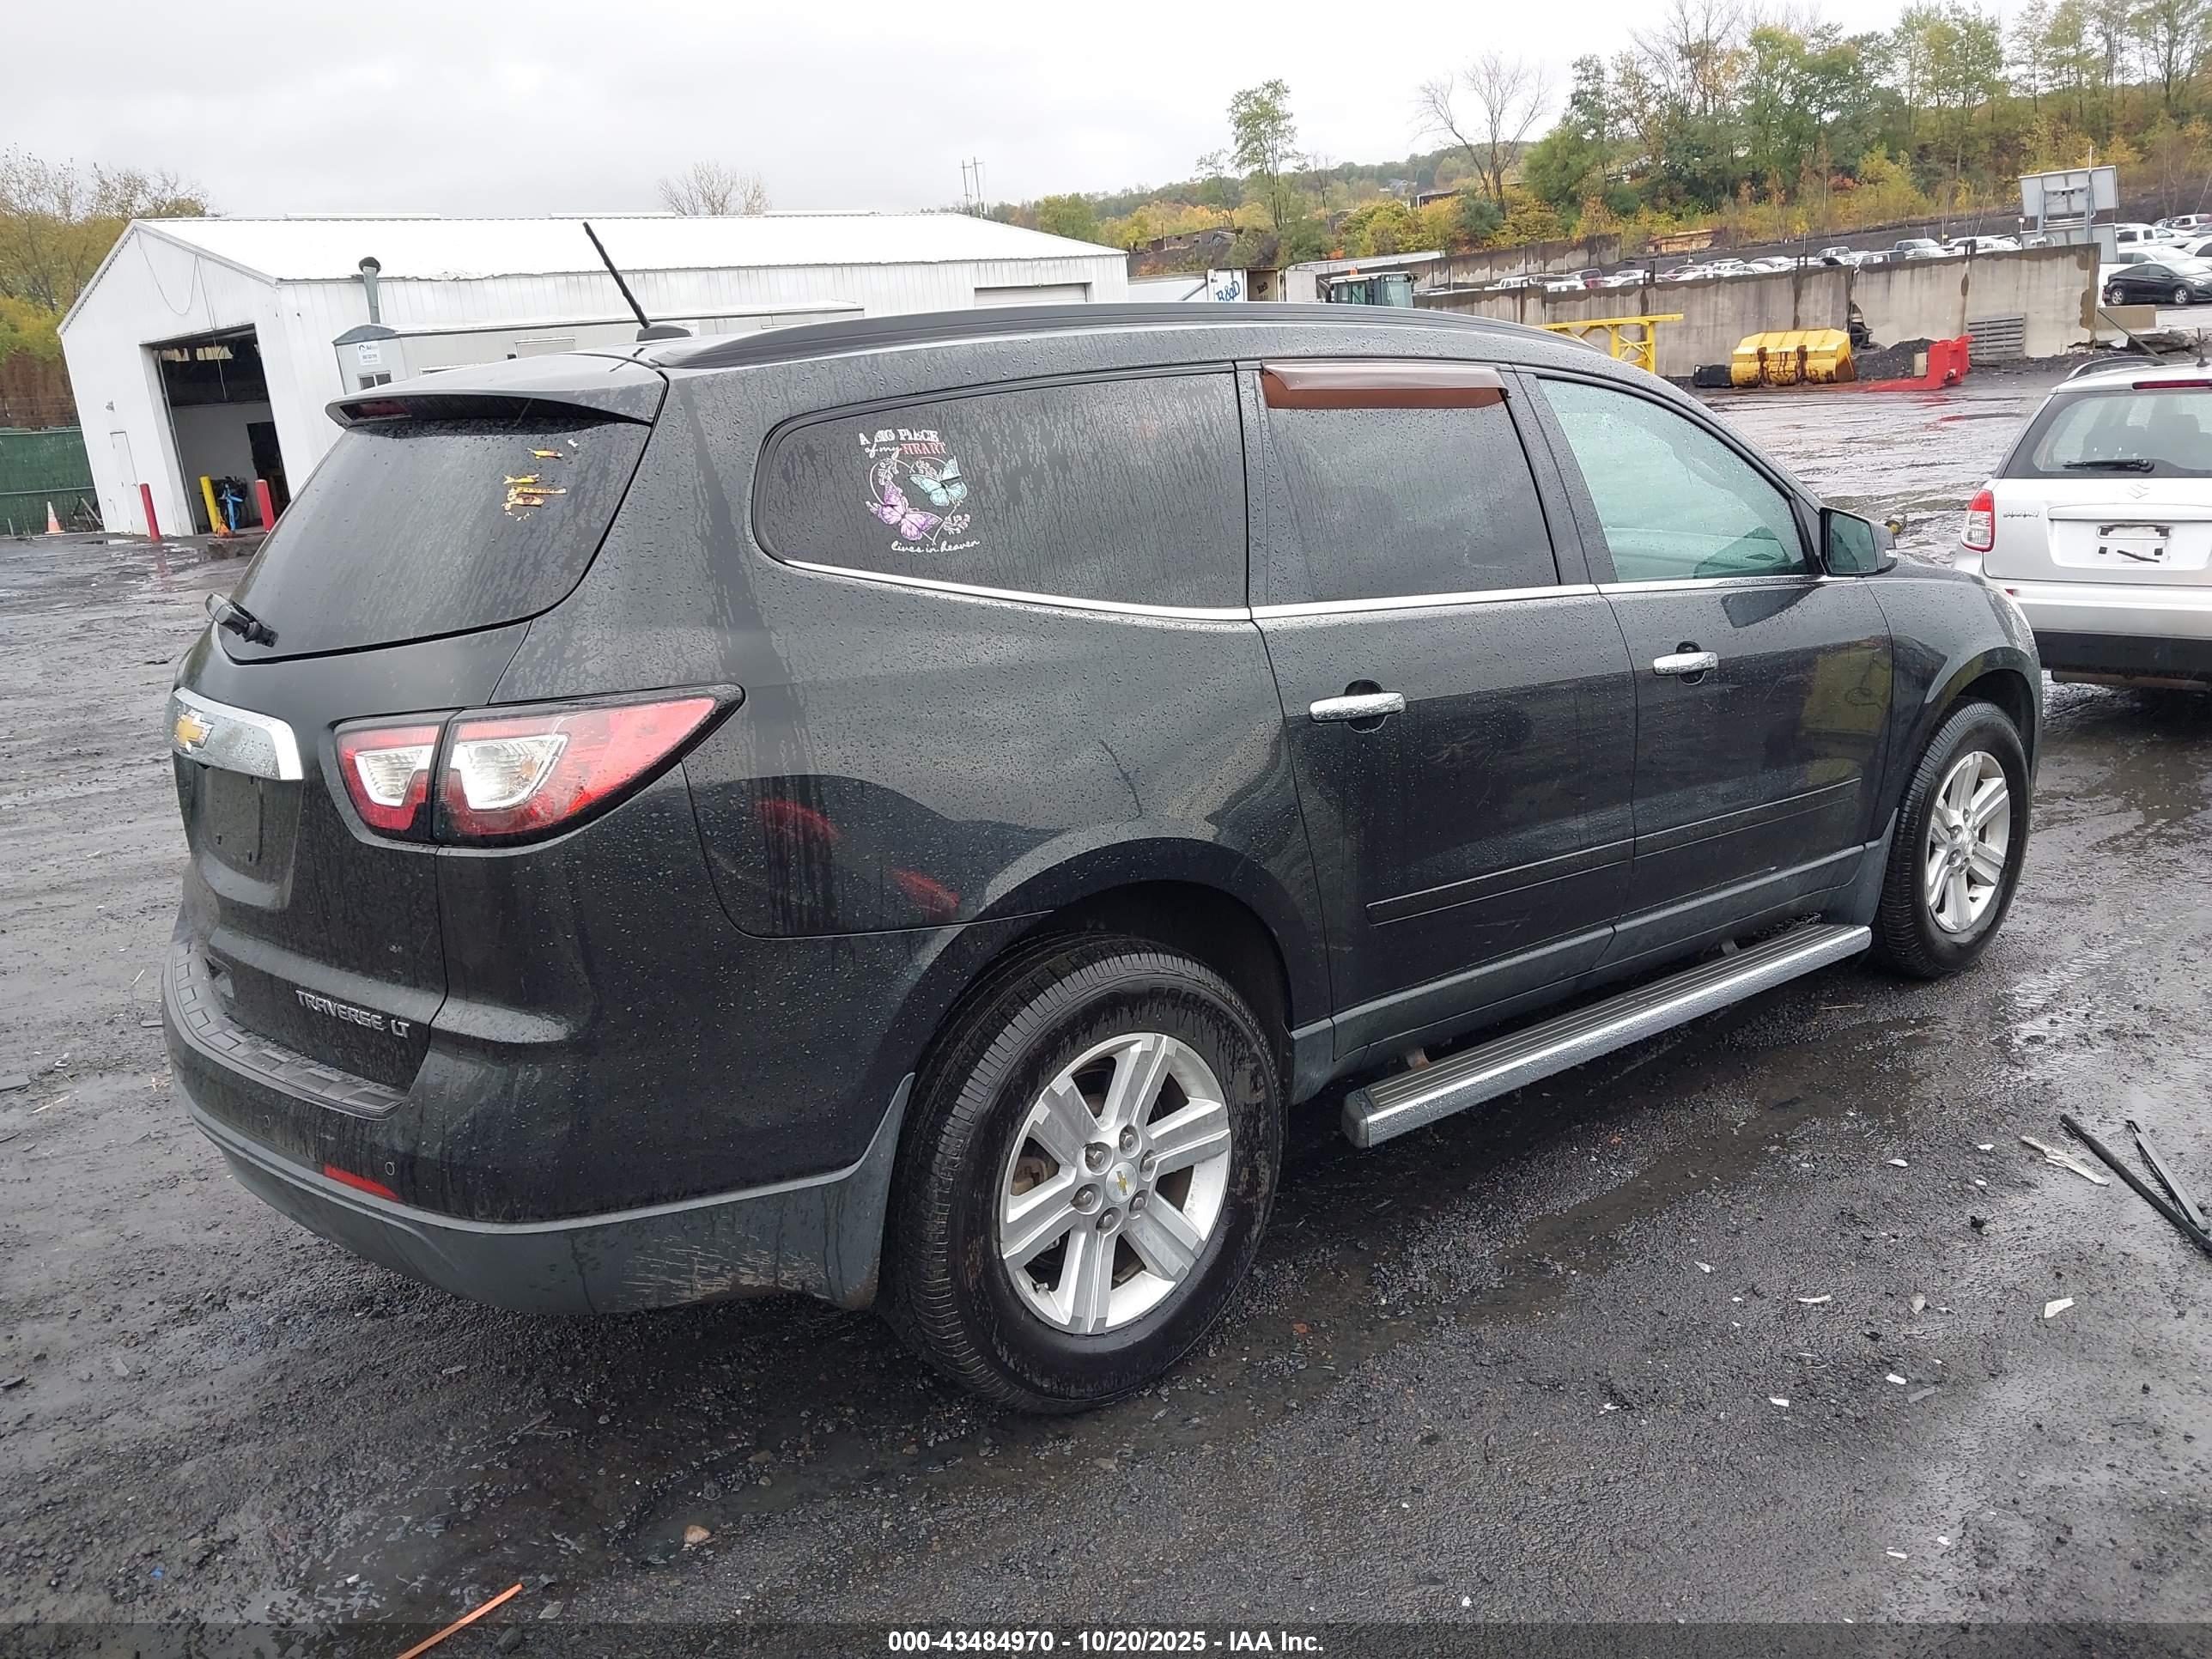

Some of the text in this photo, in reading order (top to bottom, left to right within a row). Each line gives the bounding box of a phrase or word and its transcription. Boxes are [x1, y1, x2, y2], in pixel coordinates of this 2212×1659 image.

[859, 433, 871, 446] A
[896, 428, 940, 442] PIECE
[864, 441, 946, 461] of my HEART
[891, 540, 981, 553] lives in heaven
[295, 989, 410, 1039] TRAVERSE LT
